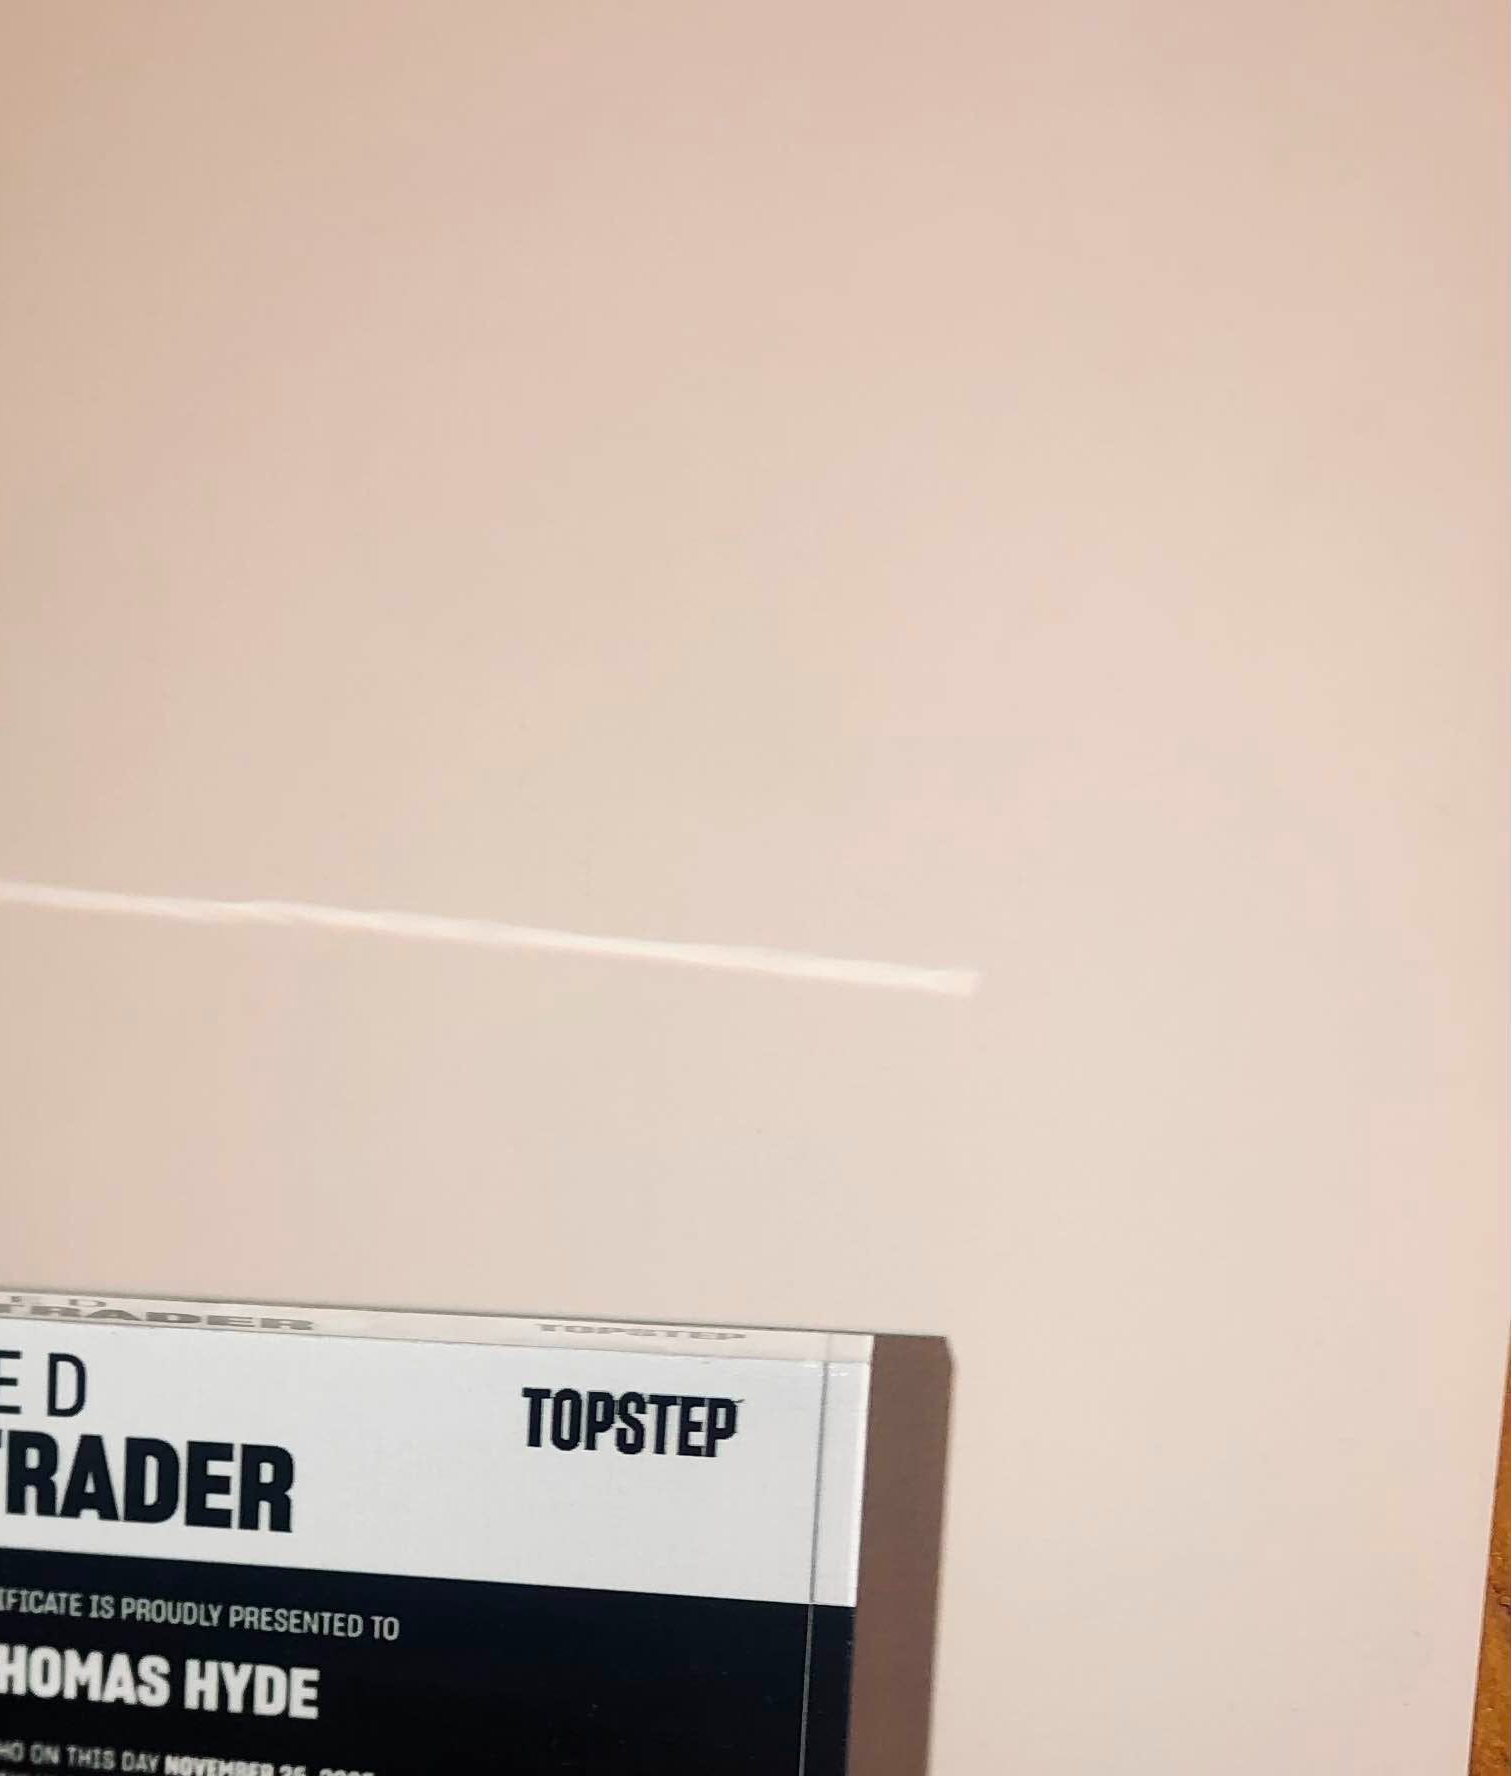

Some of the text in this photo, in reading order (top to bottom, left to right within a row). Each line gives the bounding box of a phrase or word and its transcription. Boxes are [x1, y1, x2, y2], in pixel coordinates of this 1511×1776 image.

[522, 1387, 739, 1458] TOPSTEP
[89, 1594, 115, 1620] IS
[120, 1597, 225, 1628] PROUDLY
[229, 1605, 364, 1638] PRESENTED
[370, 1615, 401, 1641] TO
[184, 1658, 321, 1719] HYDE
[30, 1743, 60, 1766] ON
[67, 1745, 116, 1772] THIS
[121, 1751, 160, 1775] DAY
